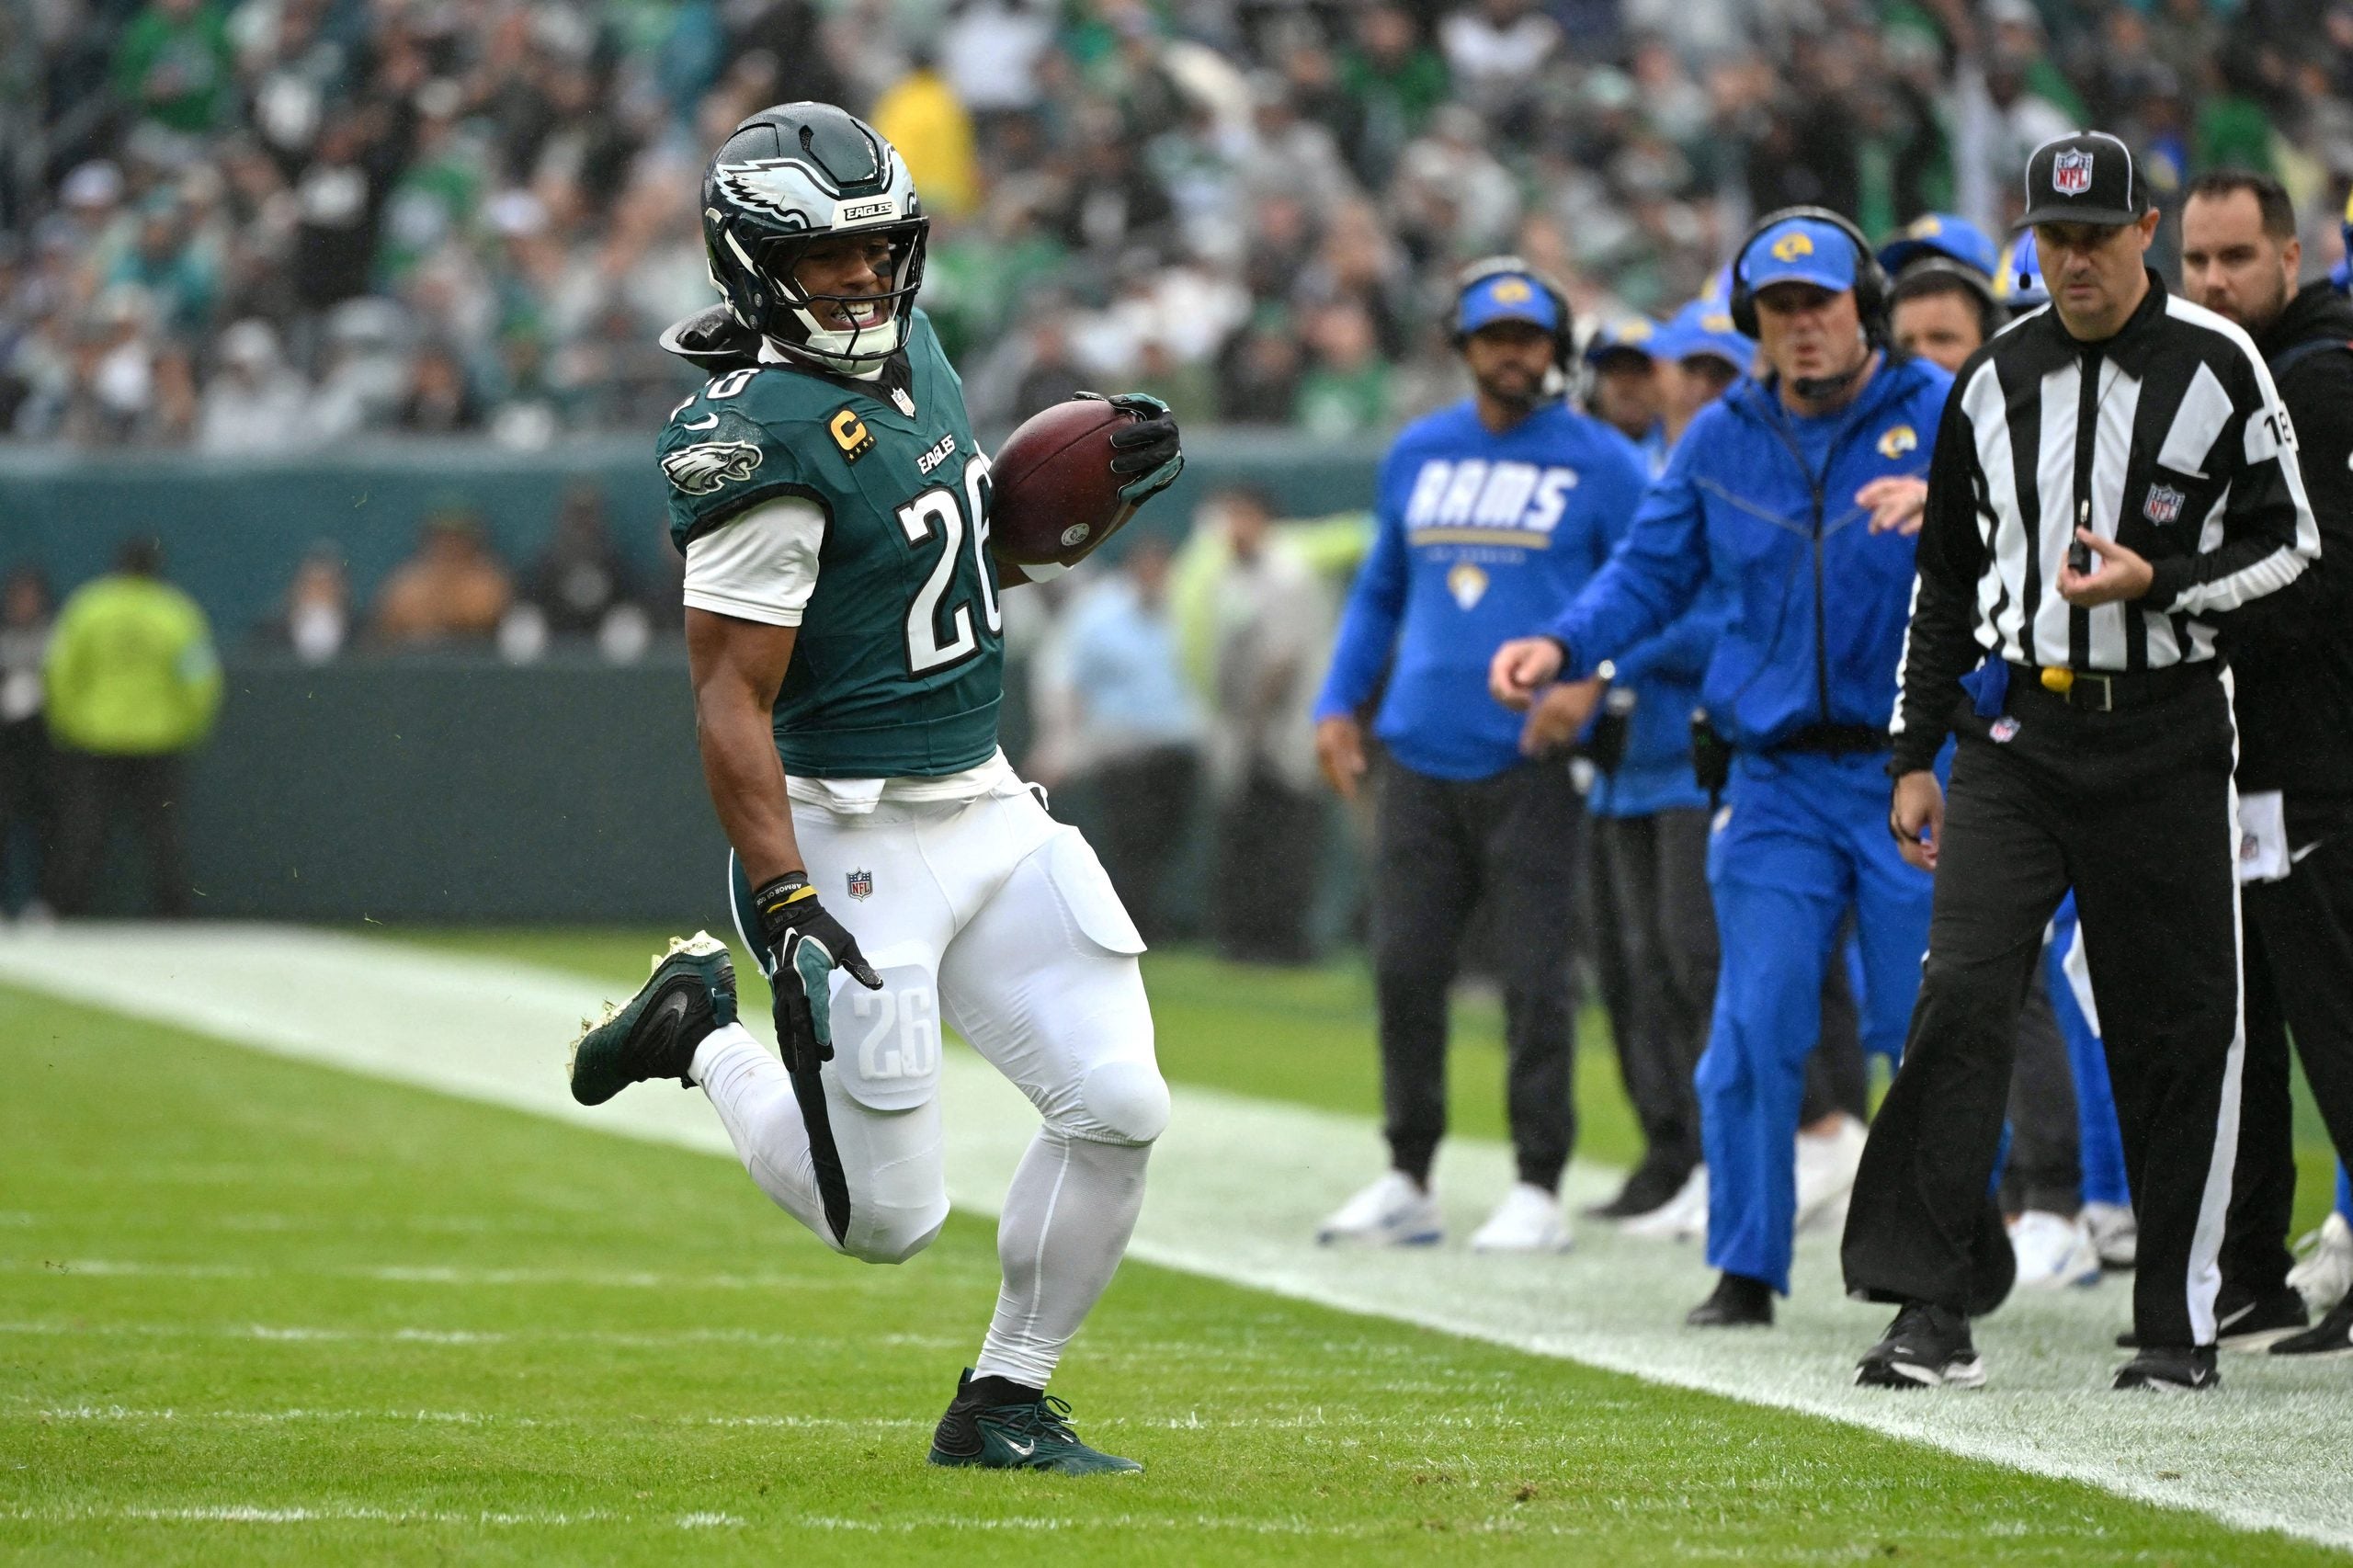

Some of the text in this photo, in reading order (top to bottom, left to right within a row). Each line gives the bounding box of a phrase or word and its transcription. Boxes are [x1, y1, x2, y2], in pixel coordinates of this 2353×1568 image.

[2058, 168, 2089, 189] NFL
[846, 202, 892, 220] EAGLES
[830, 409, 867, 451] C
[2263, 411, 2292, 446] 18
[915, 434, 957, 475] EAGLES
[1405, 458, 1579, 530] RAMS
[2149, 499, 2176, 522] NFL
[774, 882, 802, 895] ARMOR
[851, 882, 870, 895] NFL
[852, 986, 936, 1082] 26
